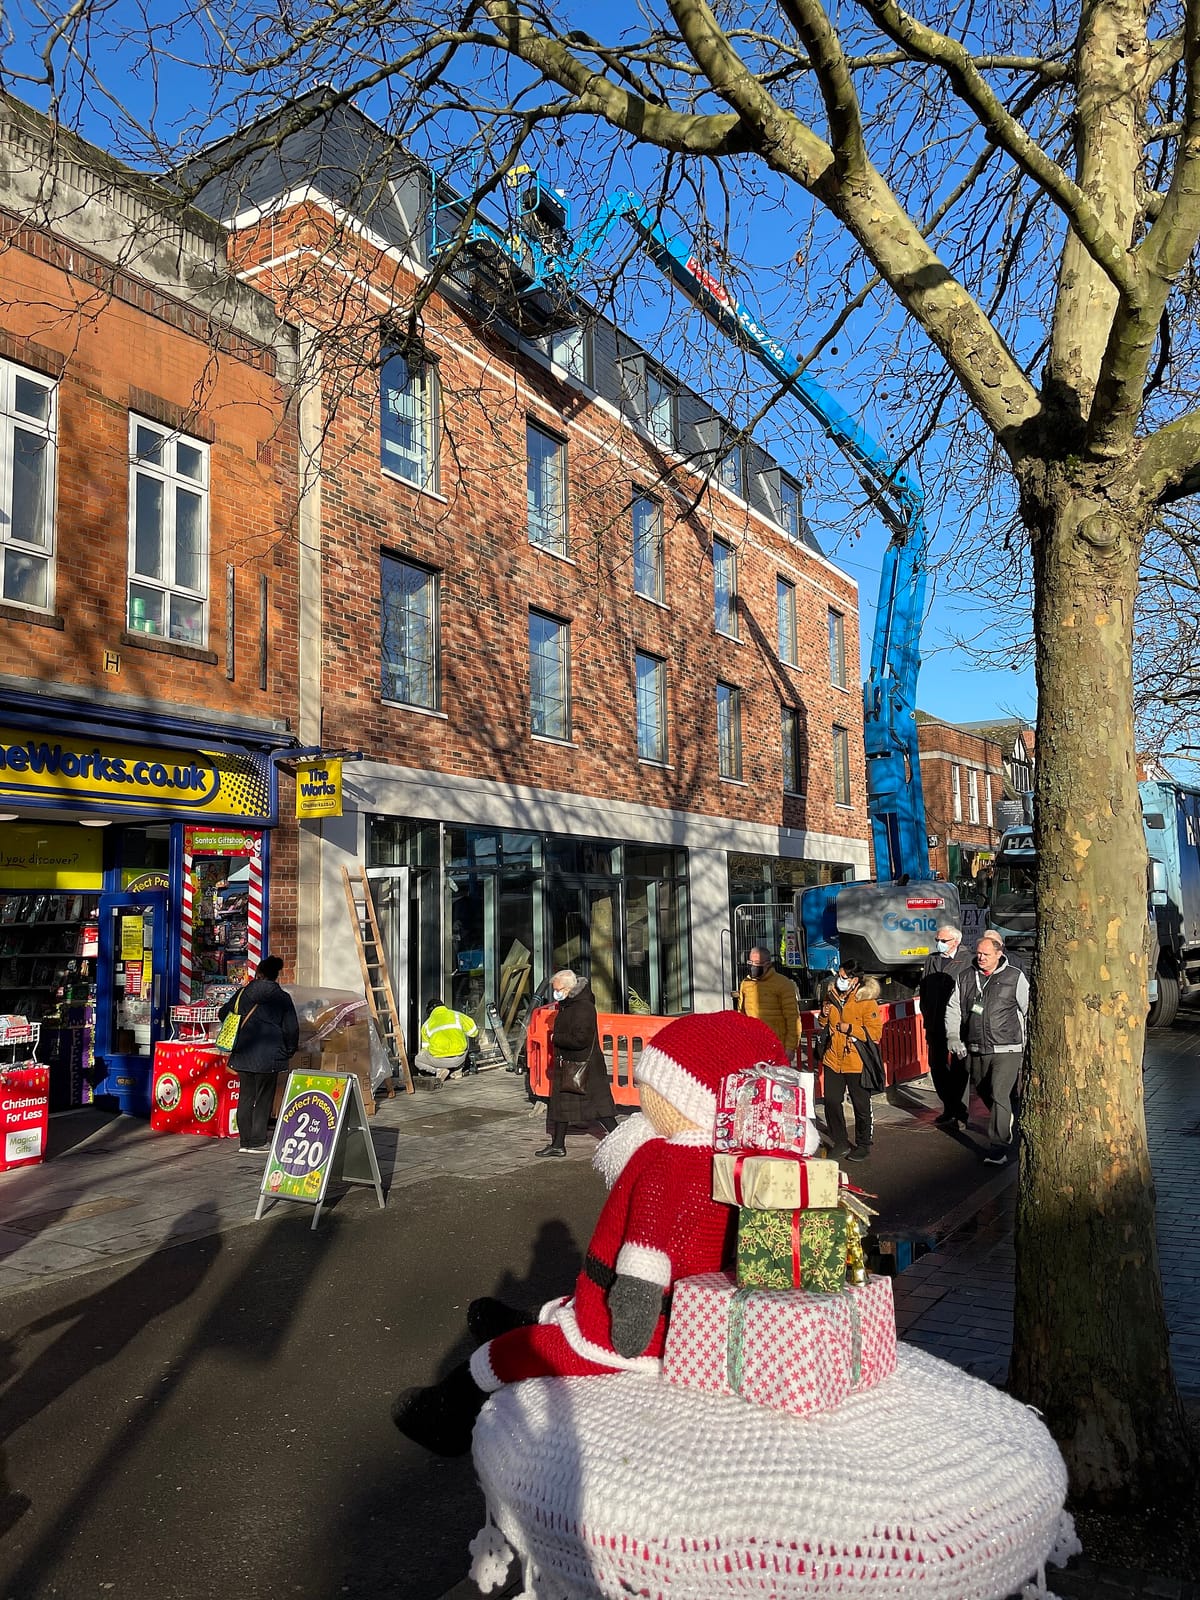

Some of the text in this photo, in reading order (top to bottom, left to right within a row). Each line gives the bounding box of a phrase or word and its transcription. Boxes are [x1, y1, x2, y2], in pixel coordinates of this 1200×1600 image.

[0, 741, 207, 791] eWorks.co.uk
[308, 768, 329, 782] The
[300, 781, 336, 797] Works
[195, 836, 244, 845] Santa's Giftshop
[1007, 836, 1035, 849] HA
[6, 856, 26, 865] you
[28, 851, 80, 865] discover?
[132, 876, 169, 893] rfect Pre
[883, 911, 938, 932] Genie
[960, 909, 983, 926] EY
[230, 1091, 240, 1101] Fo
[2, 1096, 48, 1111] Christmas
[6, 1109, 43, 1123] For Less
[282, 1095, 337, 1131] Perfect Presents!
[293, 1112, 311, 1138] 2
[311, 1118, 321, 1126] For
[308, 1125, 321, 1135] Only
[9, 1133, 39, 1146] Magical
[15, 1145, 32, 1155] Gifts
[280, 1137, 324, 1168] £20
